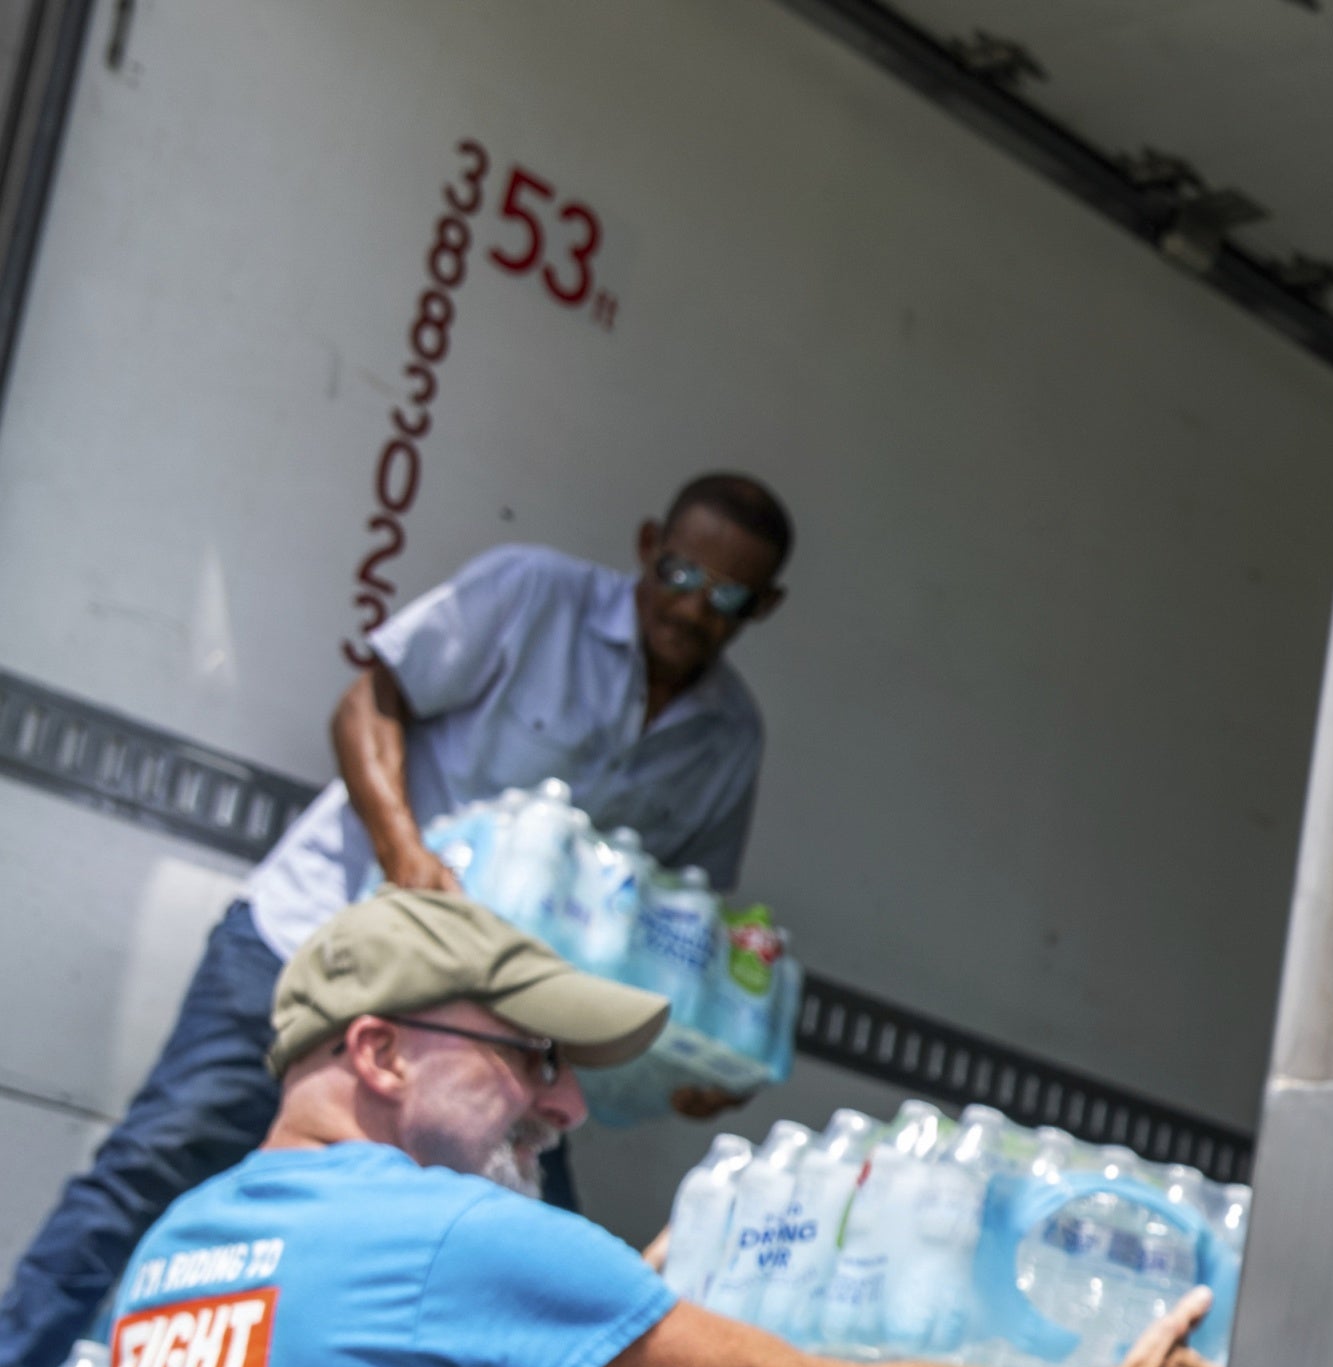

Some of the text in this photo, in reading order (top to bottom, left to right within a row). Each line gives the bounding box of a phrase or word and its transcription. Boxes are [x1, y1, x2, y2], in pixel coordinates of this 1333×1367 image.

[486, 162, 604, 310] 53
[162, 1241, 249, 1293] RIDING
[245, 1237, 285, 1280] TO
